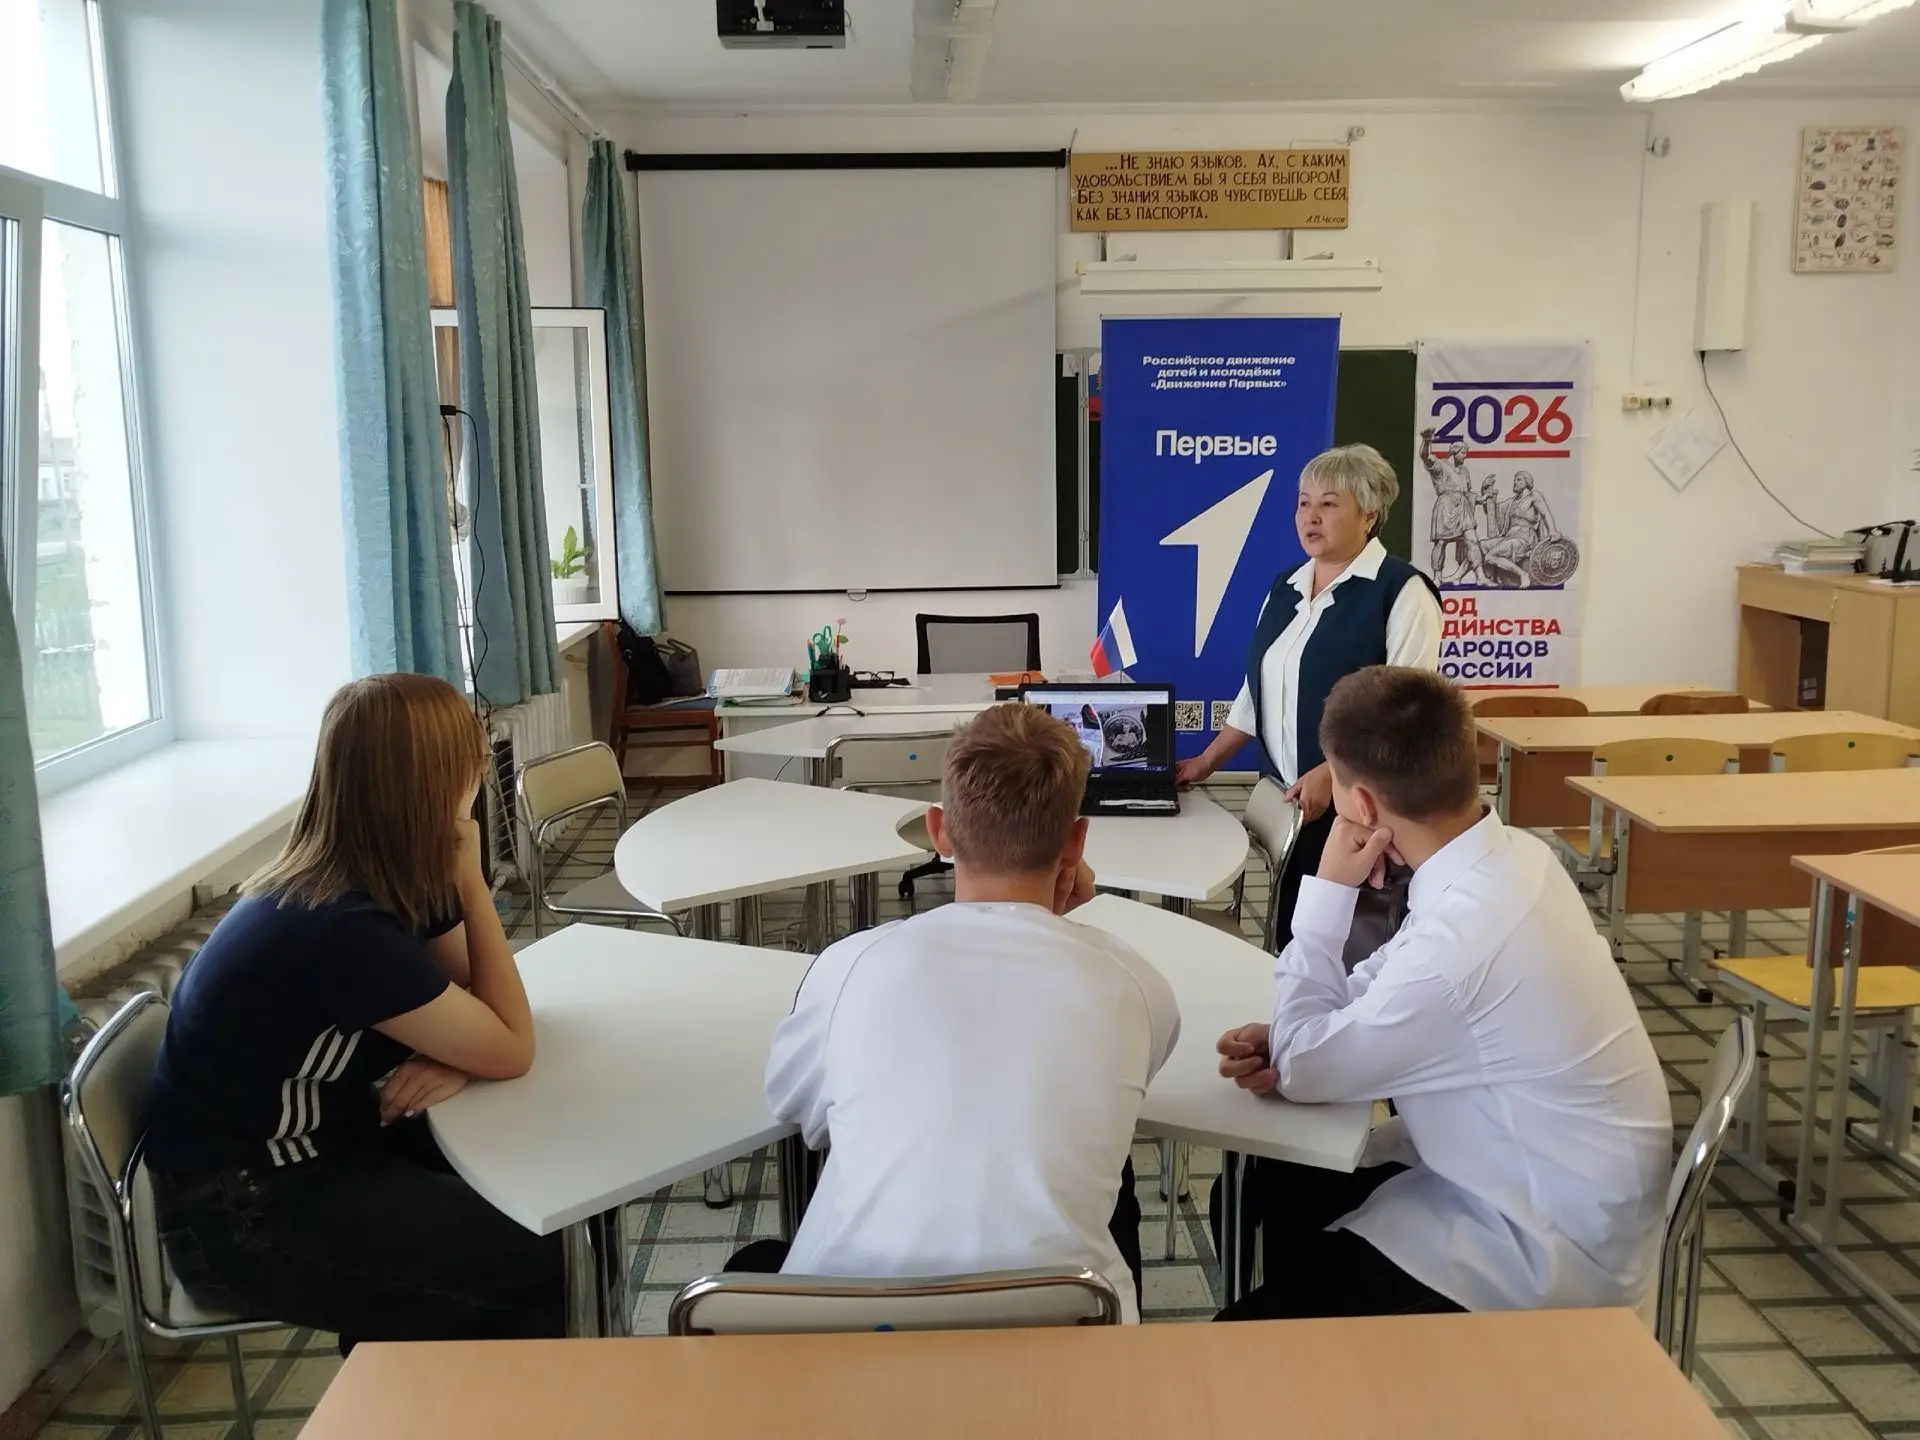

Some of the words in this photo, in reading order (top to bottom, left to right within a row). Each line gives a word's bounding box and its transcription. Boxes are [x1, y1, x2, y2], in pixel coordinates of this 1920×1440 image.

[1146, 155, 1184, 170] ЗНАЮ
[1191, 155, 1247, 169] ЯЗЫКОВ.
[1257, 153, 1279, 169] АХ,
[1286, 154, 1297, 168] С
[1302, 153, 1346, 168] КАКИМ
[1075, 172, 1188, 188] УДОВОЛЬСТВИЕМ
[1193, 172, 1212, 186] БЫ
[1219, 172, 1227, 185] Я
[1233, 172, 1267, 185] СЕБЯ
[1272, 169, 1340, 185] ВЫПОРОЛ!
[1077, 189, 1104, 204] БЕЗ
[1111, 189, 1159, 204] ЗНАНИЯ
[1165, 189, 1219, 203] ЯЗЫКОВ
[1224, 187, 1307, 203] ЧУВСТВУЕШЬ
[1076, 207, 1100, 221] КАК
[1106, 207, 1131, 221] БЕЗ
[1136, 206, 1209, 220] ПАСПОРТА.
[1142, 355, 1224, 366] Российское
[1225, 355, 1296, 367] движение
[1157, 367, 1197, 379] детей
[1199, 368, 1208, 377] и
[1210, 367, 1281, 379] молодёжи
[1150, 379, 1226, 390] «Движение
[1228, 378, 1287, 390] Первых»
[1430, 394, 1573, 444] 2026
[1155, 429, 1278, 464] Первые
[1442, 597, 1478, 617] ОД
[1441, 618, 1562, 639] ДИНСТВА
[1437, 661, 1533, 679] ОССИИ
